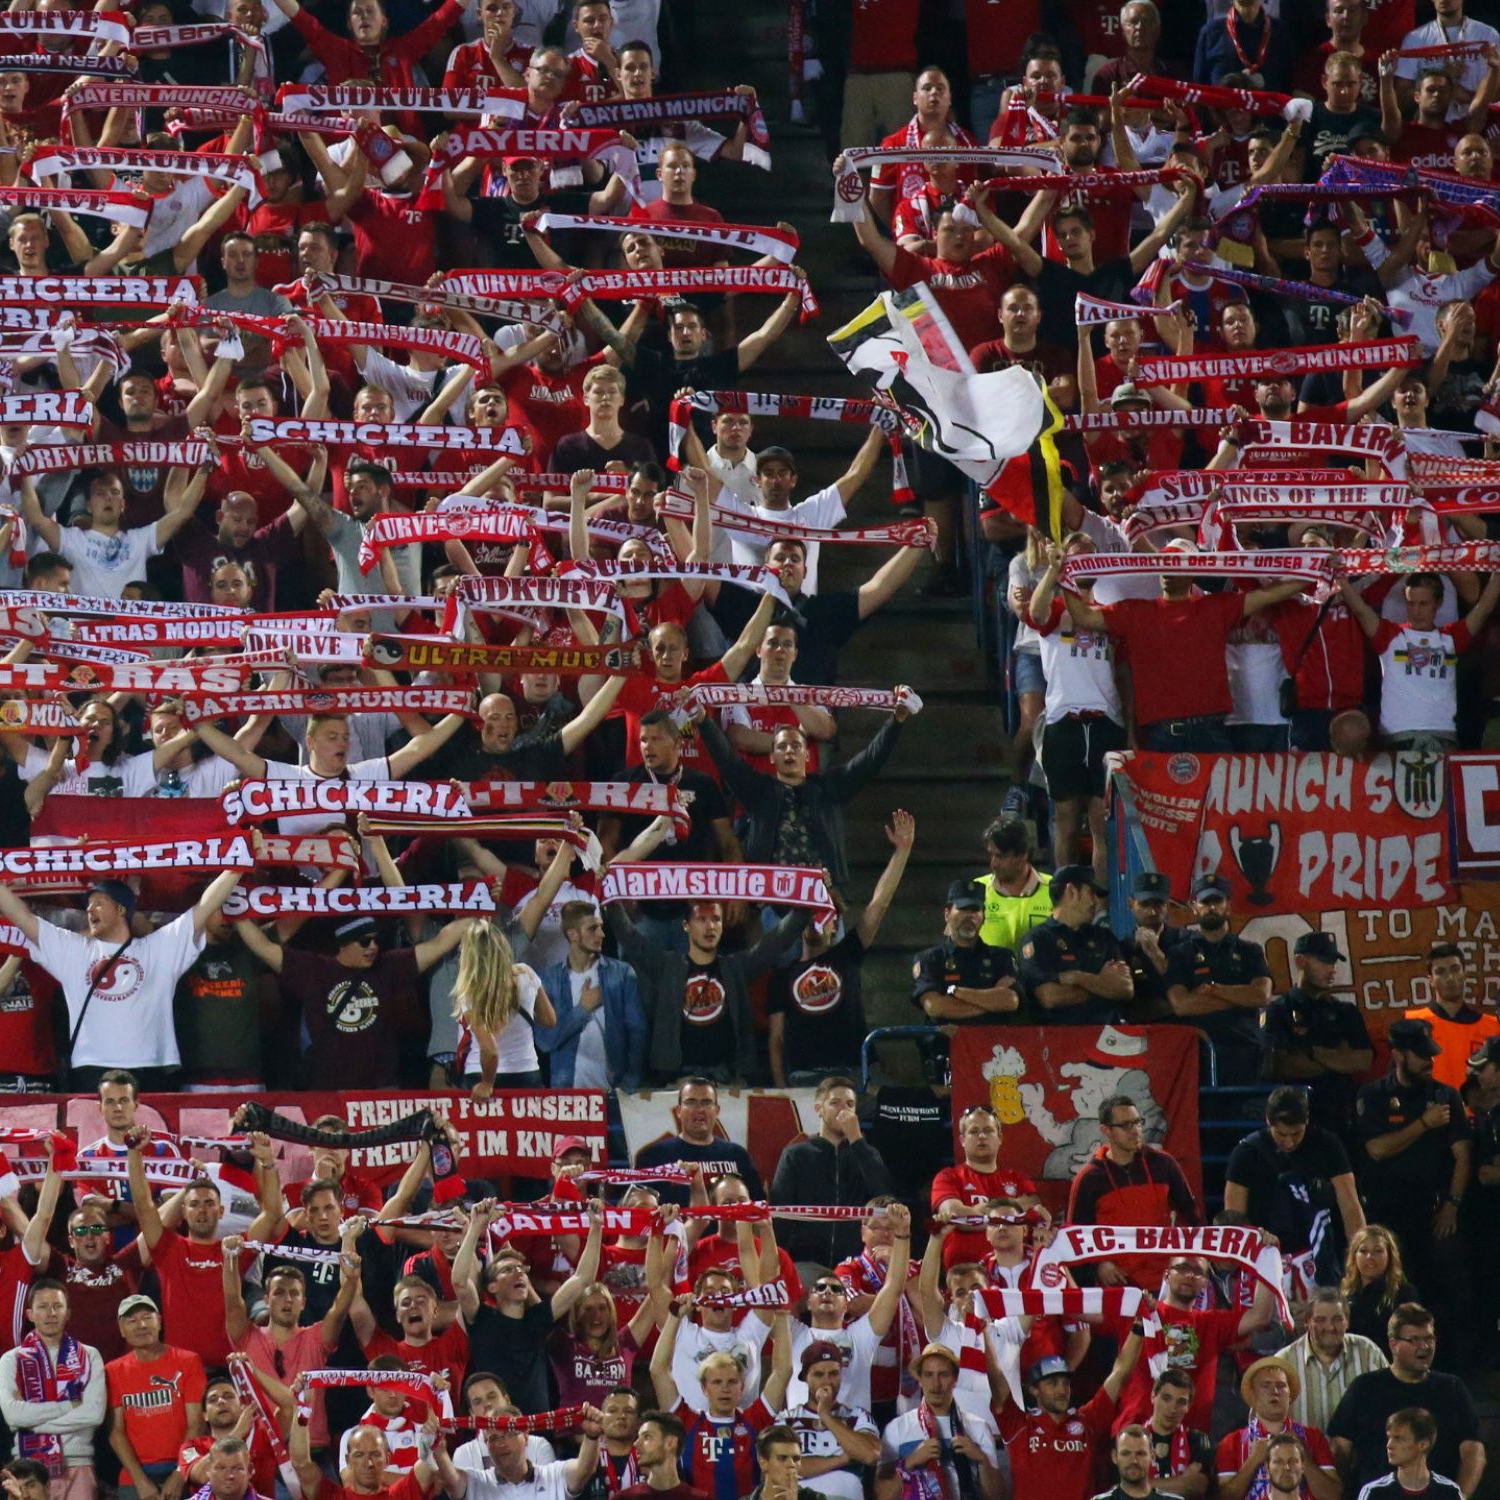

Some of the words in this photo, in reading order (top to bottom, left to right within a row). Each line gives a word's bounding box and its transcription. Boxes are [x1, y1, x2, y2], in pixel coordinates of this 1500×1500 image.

[74, 86, 151, 103] BAYERN
[445, 131, 590, 153] BAYERN
[251, 419, 525, 456] SCHICKERIA
[1288, 487, 1316, 504] OF
[1326, 486, 1368, 503] THE
[166, 619, 245, 641] MODUS
[111, 666, 243, 692] RAS
[186, 693, 303, 722] BAYERN
[223, 777, 472, 826] SCHICKERIA
[1298, 831, 1447, 902] PRIDE
[602, 867, 765, 899] alarMstufe
[223, 884, 497, 916] SCHICKERIA
[1358, 908, 1412, 942] TO
[511, 1095, 605, 1122] UNSERE
[476, 1130, 509, 1157] IM
[1071, 1227, 1129, 1257] F.C.
[1136, 1227, 1262, 1262] BAYERN
[574, 1360, 627, 1380] BAERN
[122, 1389, 172, 1408] PUMA
